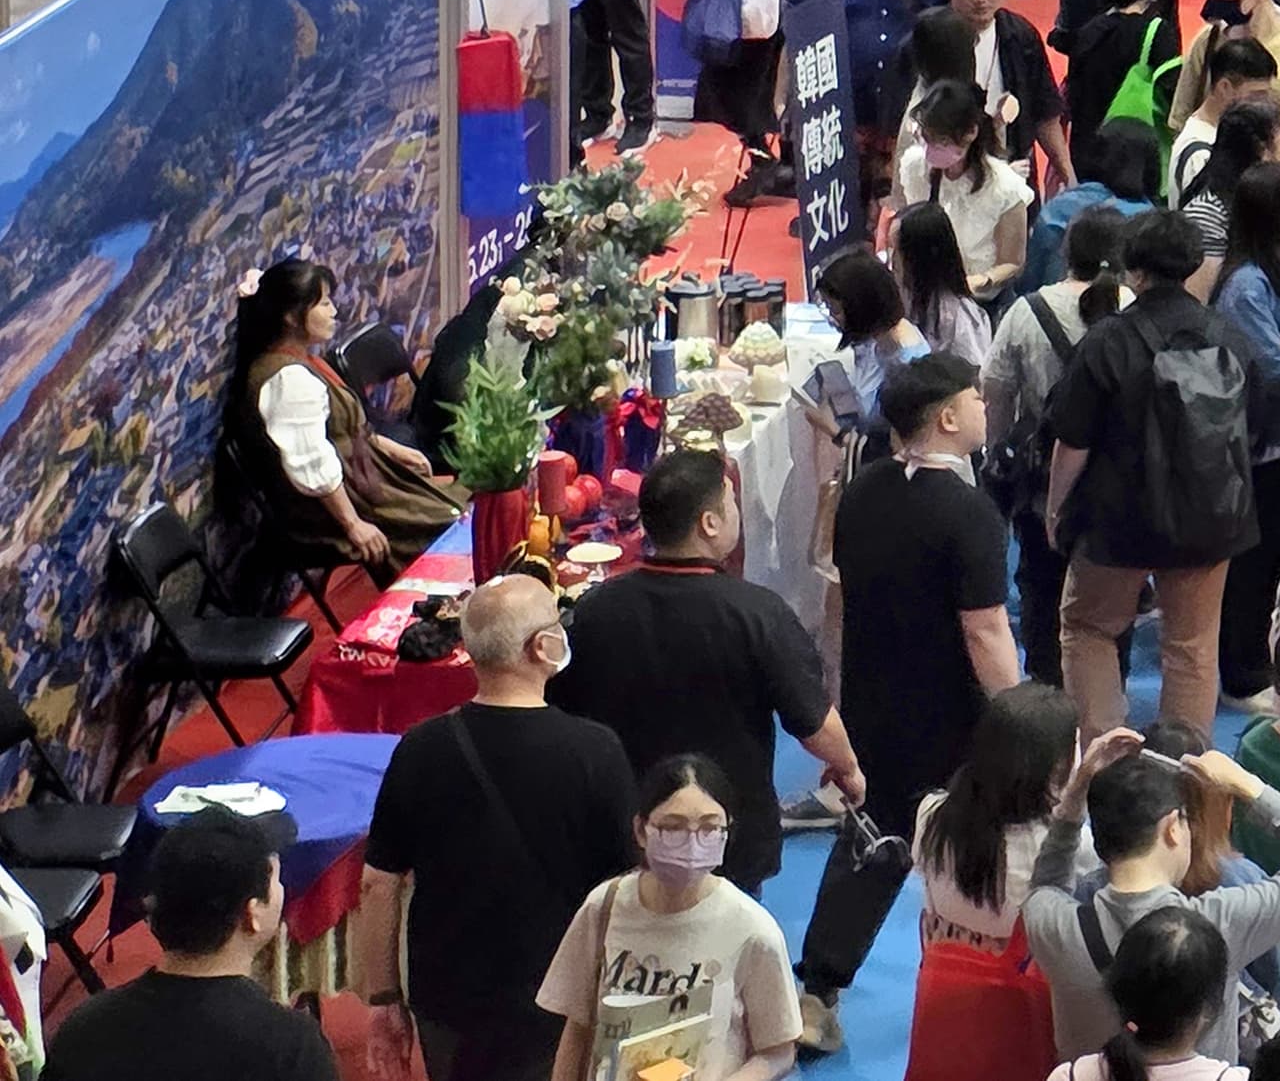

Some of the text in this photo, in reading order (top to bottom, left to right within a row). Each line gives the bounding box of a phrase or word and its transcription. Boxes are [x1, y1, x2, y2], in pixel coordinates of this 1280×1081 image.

[795, 33, 838, 109] 韓國
[801, 104, 844, 180] 傳統
[806, 177, 849, 252] 文化
